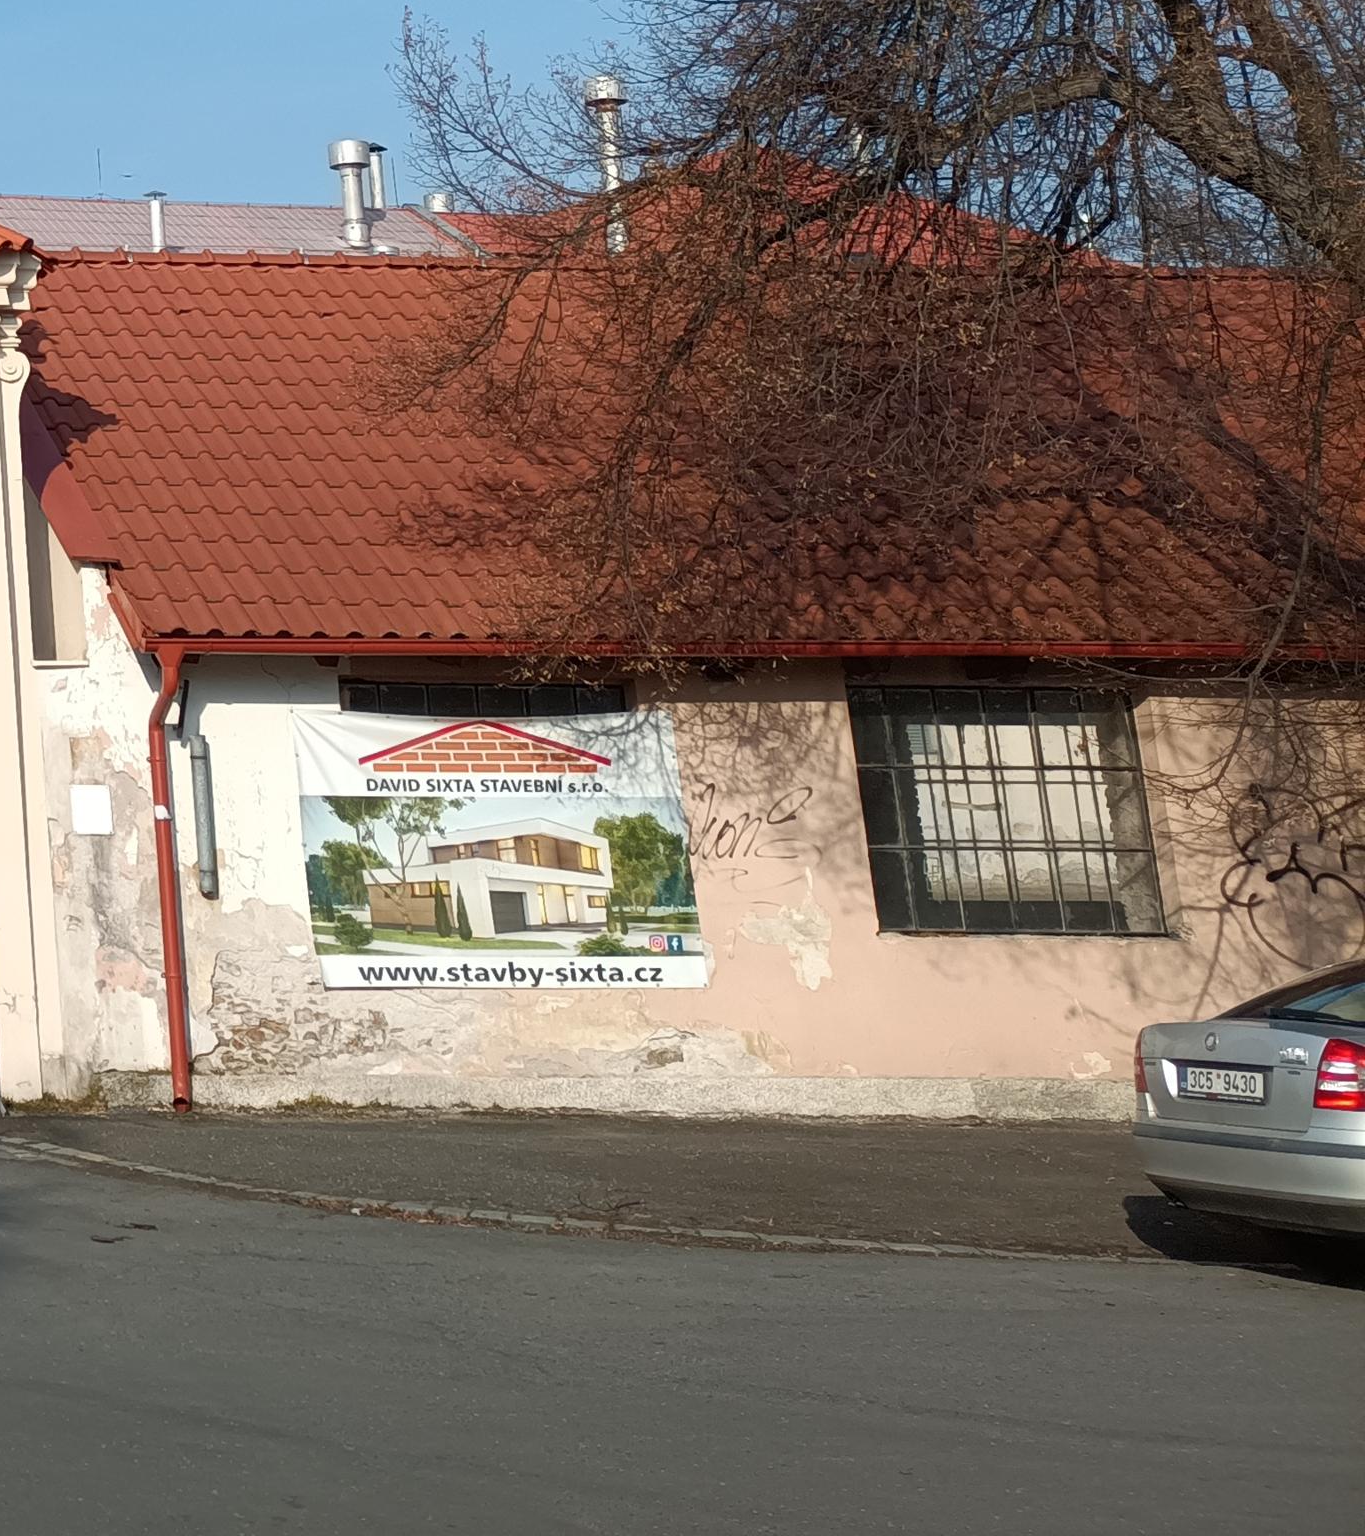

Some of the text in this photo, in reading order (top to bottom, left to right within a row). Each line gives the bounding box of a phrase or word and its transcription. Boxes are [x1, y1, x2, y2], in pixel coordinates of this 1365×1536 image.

[366, 775, 609, 793] DAVID SIXTA STAVEBNÍ s.r.o.
[358, 961, 664, 987] www.stavby-sixta.cz
[1190, 1070, 1257, 1094] 3C5 9430
